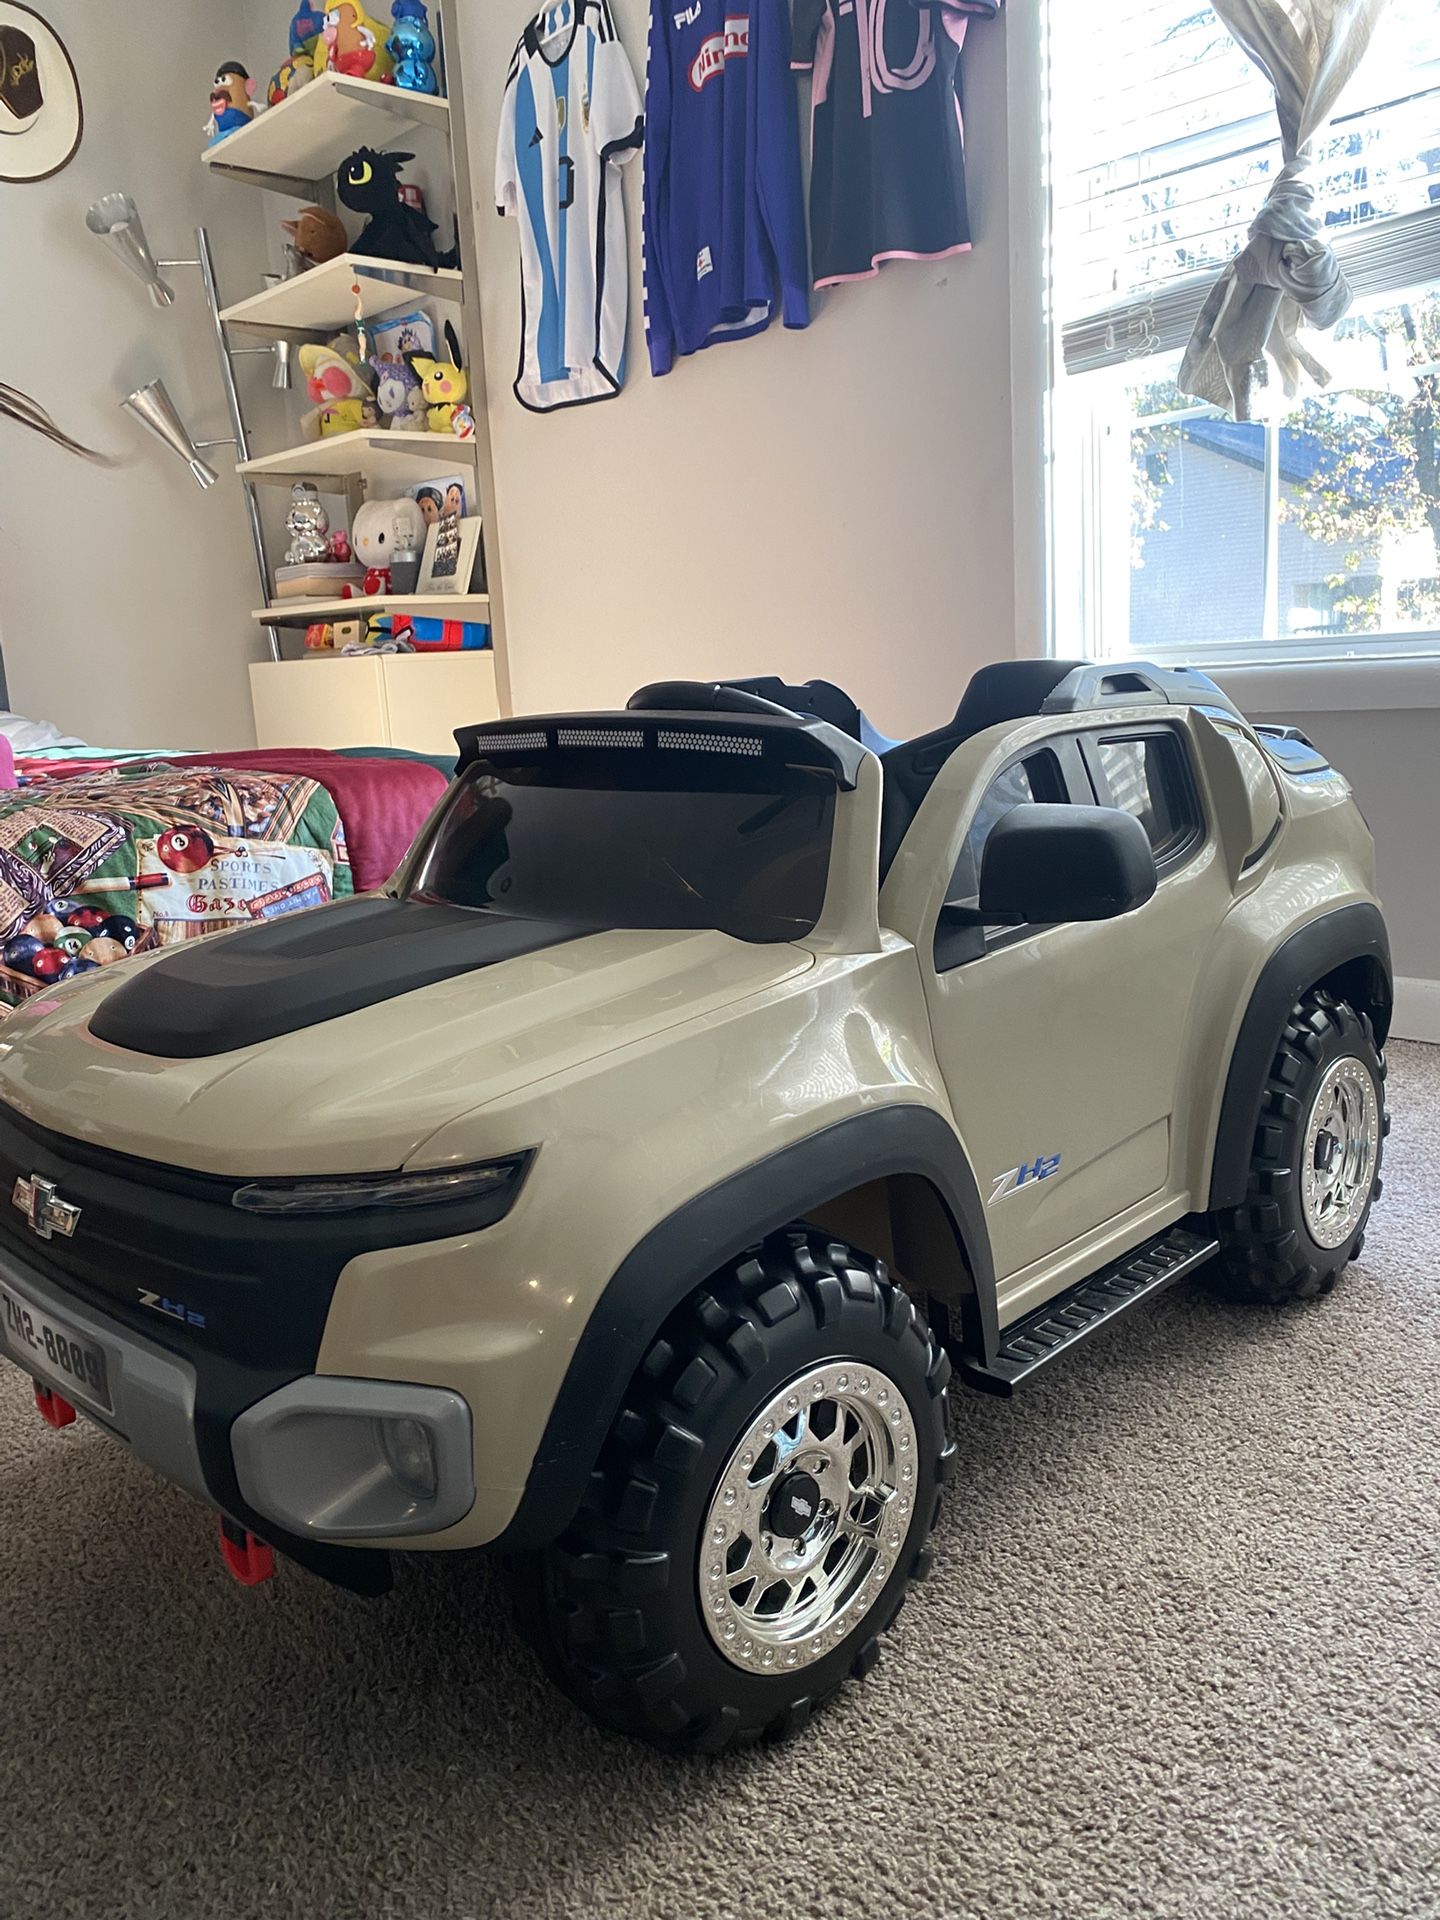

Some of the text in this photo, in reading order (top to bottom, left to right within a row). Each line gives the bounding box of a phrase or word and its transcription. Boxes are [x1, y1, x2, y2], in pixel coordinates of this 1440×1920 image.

[174, 836, 186, 847] 3
[210, 858, 272, 874] SPORTS
[197, 877, 280, 892] PASTIMES
[186, 893, 249, 915] Gaze
[68, 941, 79, 950] 14
[986, 1153, 1062, 1208] ZH2
[137, 1287, 206, 1329] ZH2
